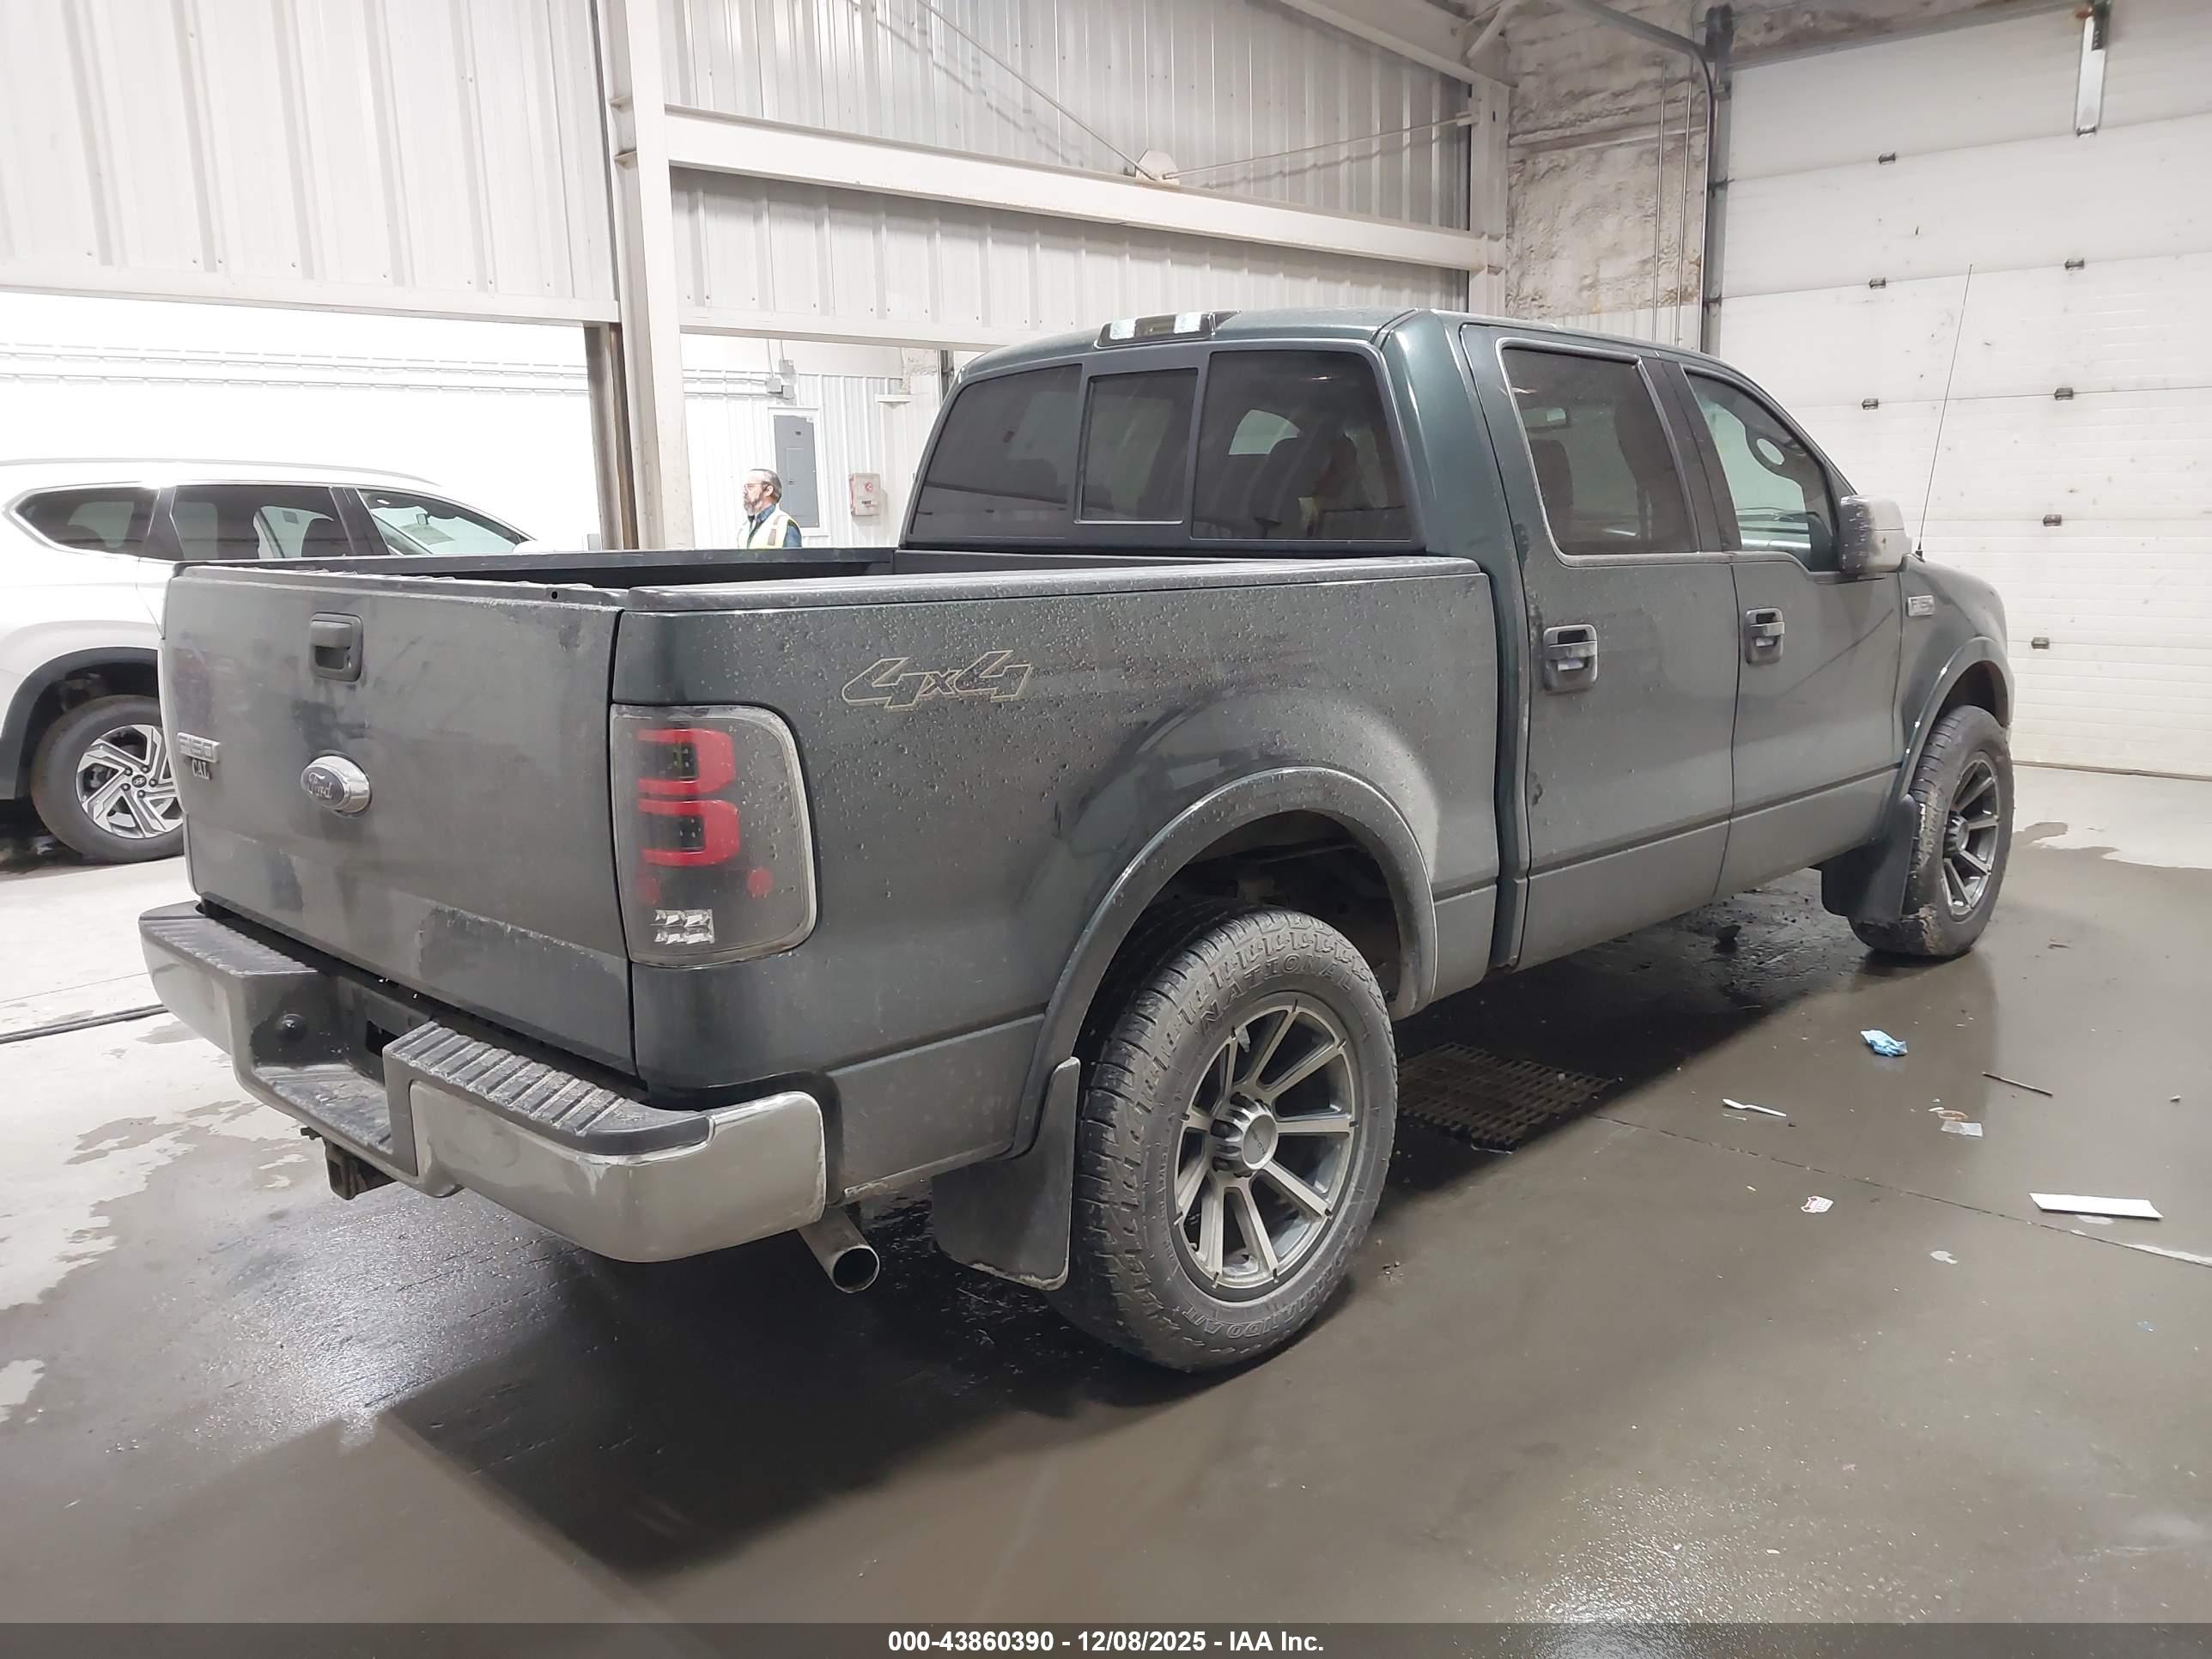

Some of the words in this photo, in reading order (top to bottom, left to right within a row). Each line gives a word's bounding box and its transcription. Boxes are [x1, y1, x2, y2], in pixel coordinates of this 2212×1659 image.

[842, 649, 1031, 714] 4x4
[309, 772, 332, 799] Ford
[1200, 953, 1352, 1036] NATIONAL
